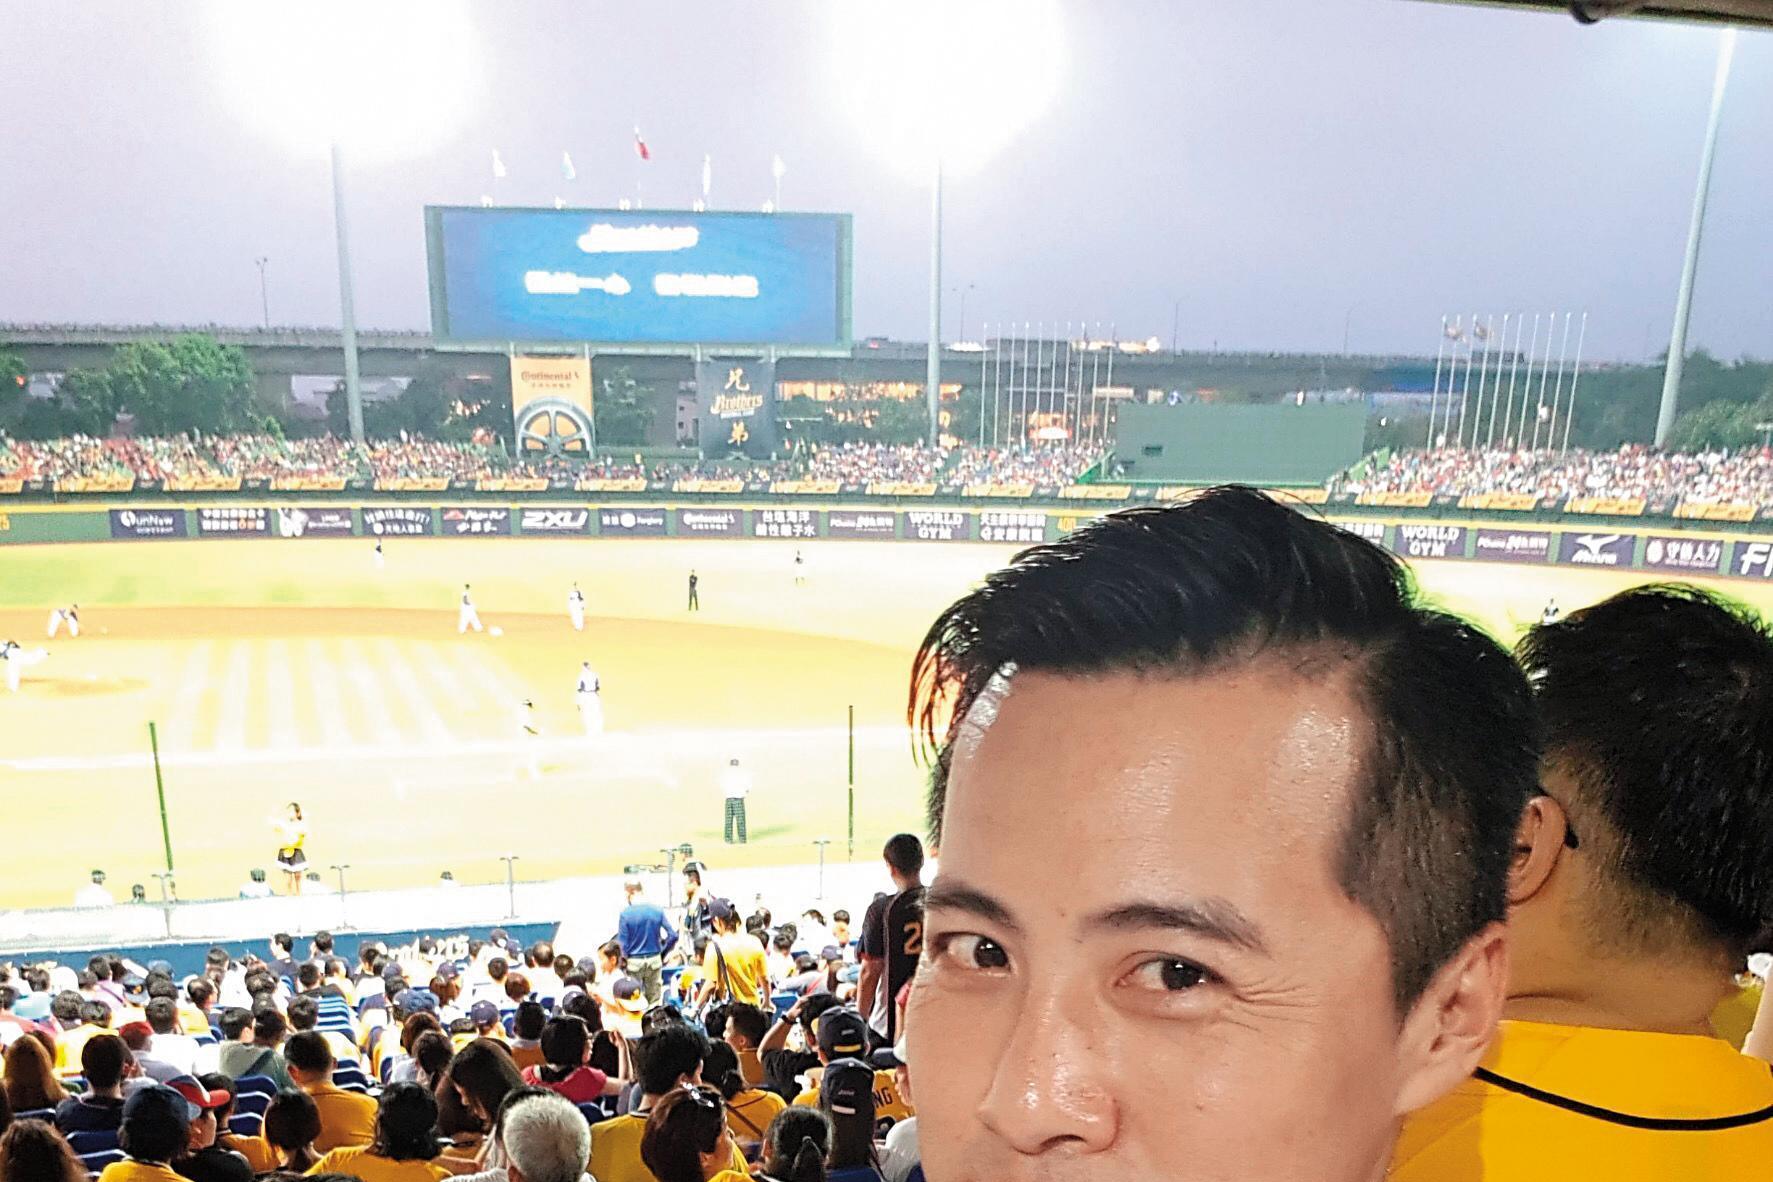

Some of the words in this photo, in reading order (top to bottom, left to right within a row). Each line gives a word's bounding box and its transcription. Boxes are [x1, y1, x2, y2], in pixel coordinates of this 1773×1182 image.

[908, 512, 964, 525] WORLD
[918, 526, 953, 540] GYM
[1400, 525, 1460, 540] WORLD
[1409, 542, 1446, 557] GYM
